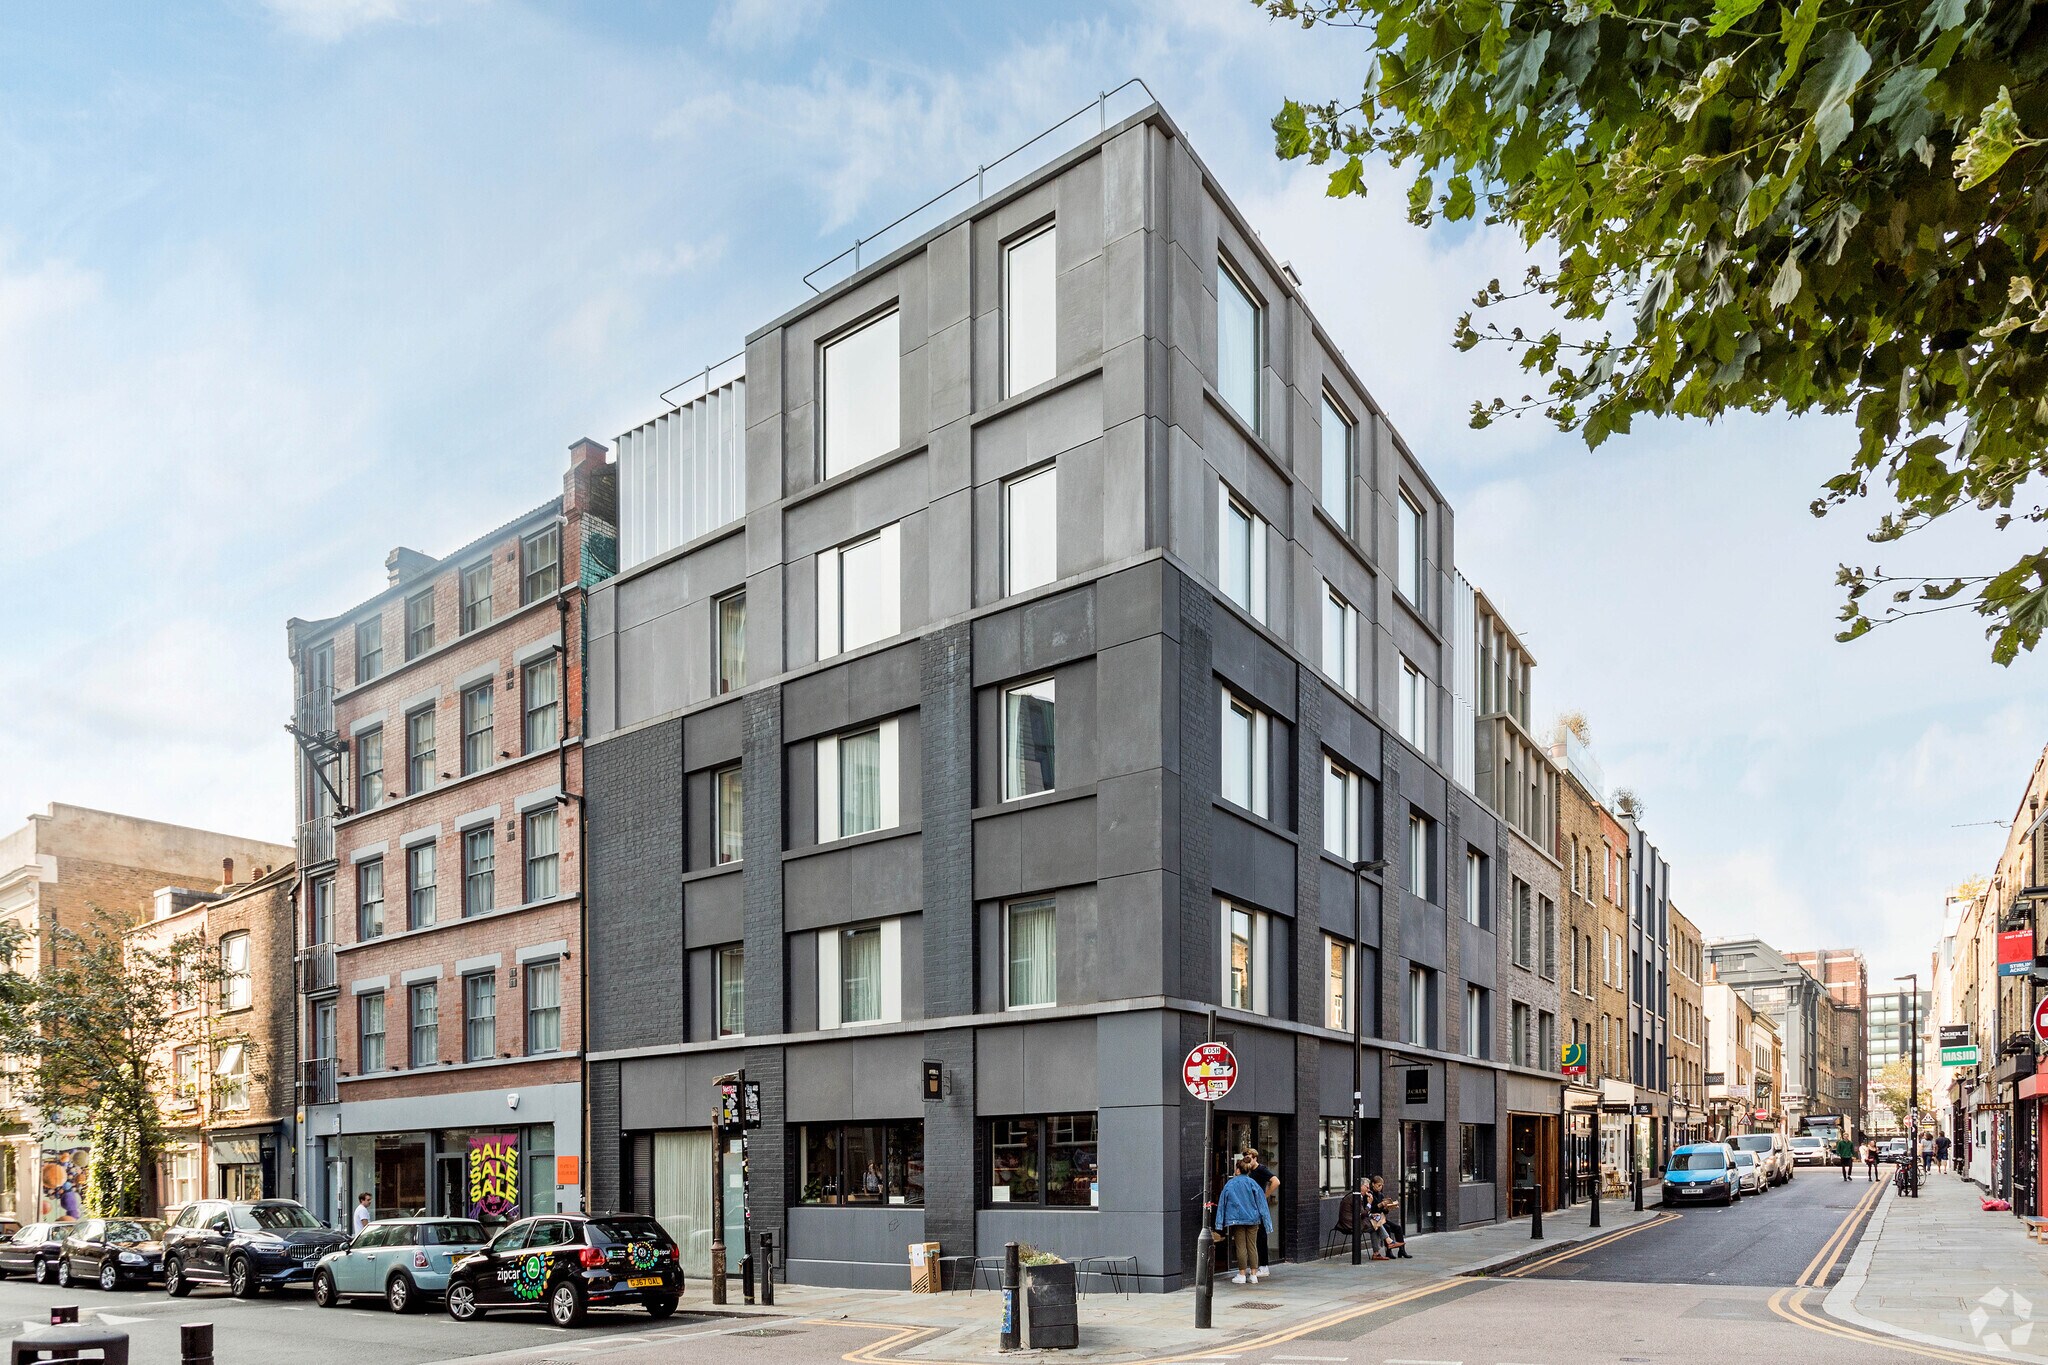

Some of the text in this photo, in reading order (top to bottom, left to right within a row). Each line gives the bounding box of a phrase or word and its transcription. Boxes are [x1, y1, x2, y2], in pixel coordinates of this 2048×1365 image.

[1943, 1051, 1976, 1062] MASJID
[470, 1142, 519, 1168] SALE
[470, 1160, 519, 1186] SALE
[470, 1179, 519, 1205] SALE
[496, 1267, 521, 1284] zipcar
